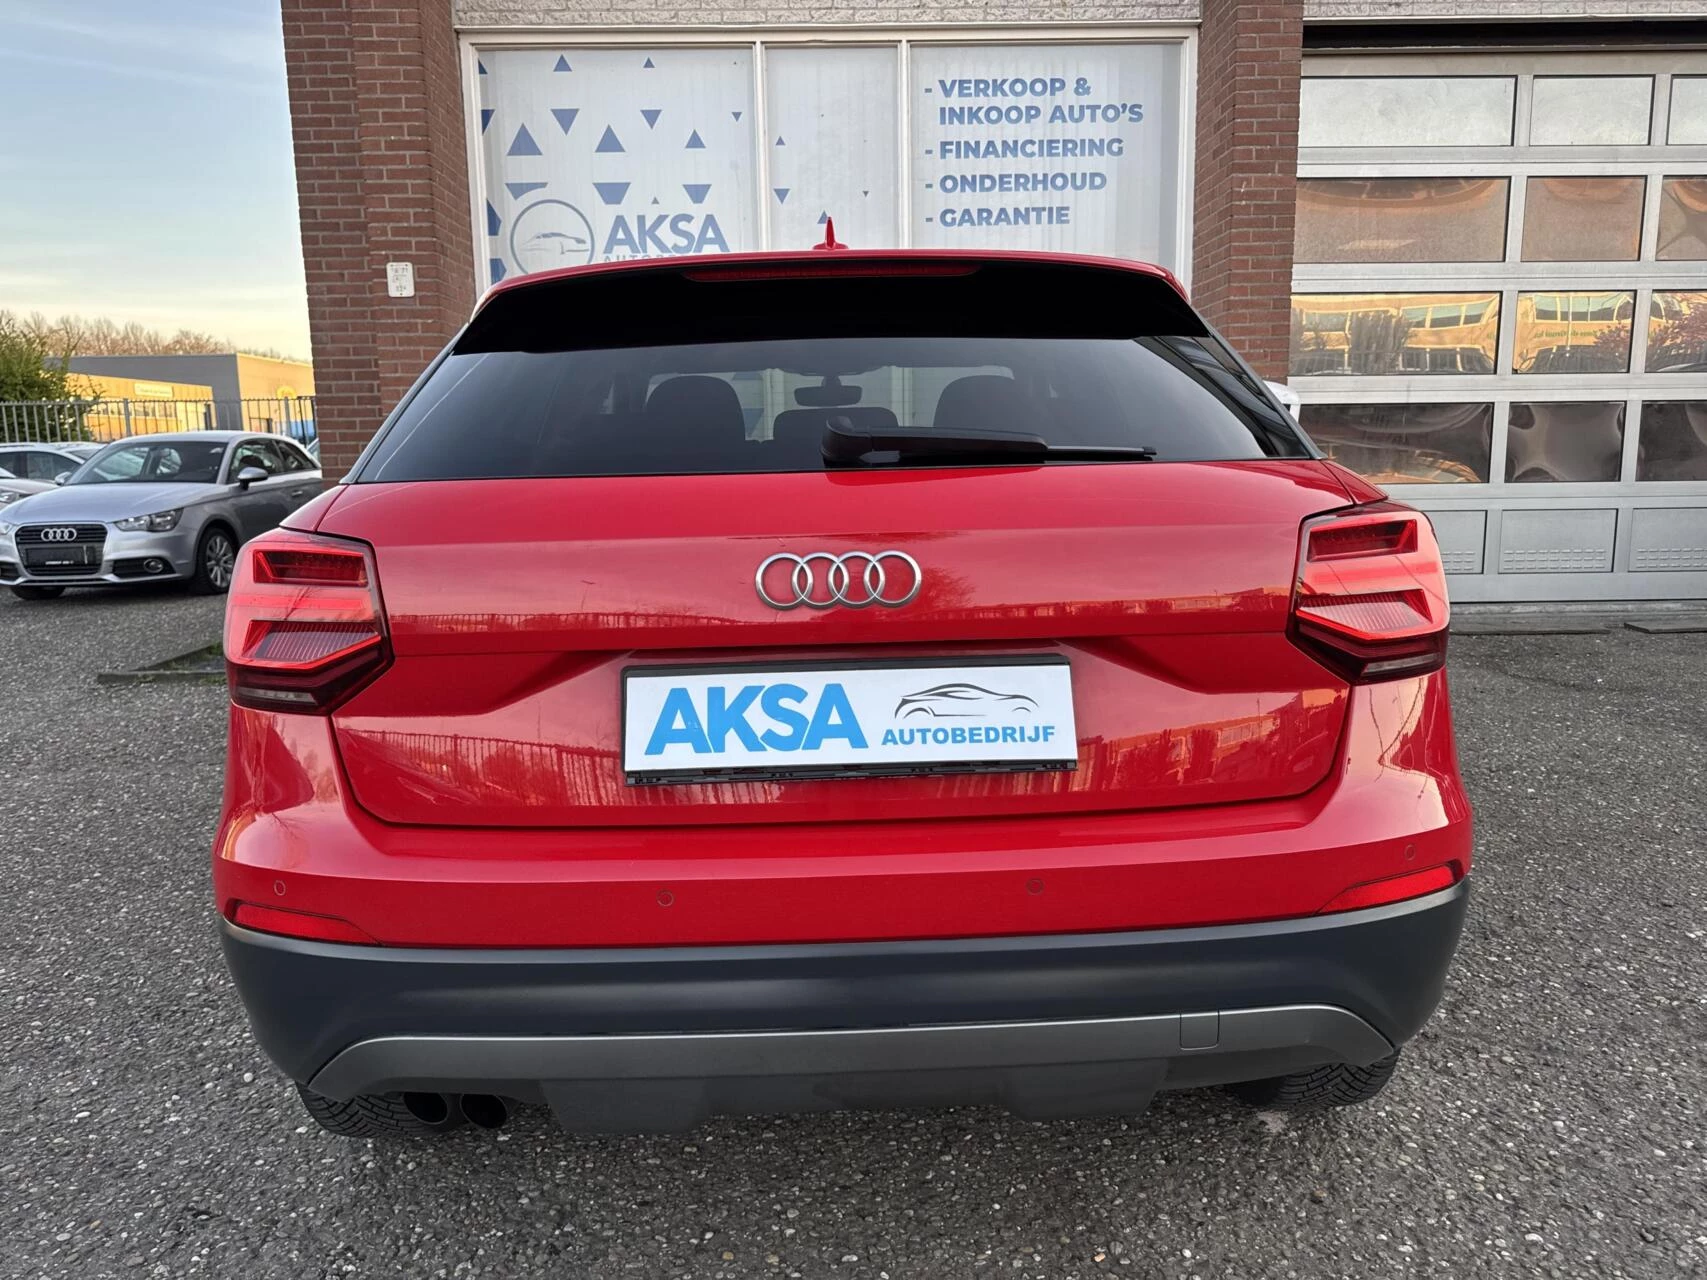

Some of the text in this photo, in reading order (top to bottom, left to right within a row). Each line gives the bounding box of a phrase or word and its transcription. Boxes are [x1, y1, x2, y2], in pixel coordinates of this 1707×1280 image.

[938, 78, 1066, 98] VERKOOP
[1073, 77, 1092, 97] &
[939, 103, 1144, 126] INKOOP AUTO'S
[939, 137, 1124, 160] FINANCIERING
[939, 172, 1107, 194] ONDERHOUD
[939, 206, 1071, 228] GARANTIE
[602, 213, 731, 254] AKSA
[643, 682, 870, 756] AKSA
[881, 725, 1056, 747] AUTOBEDRIJF
